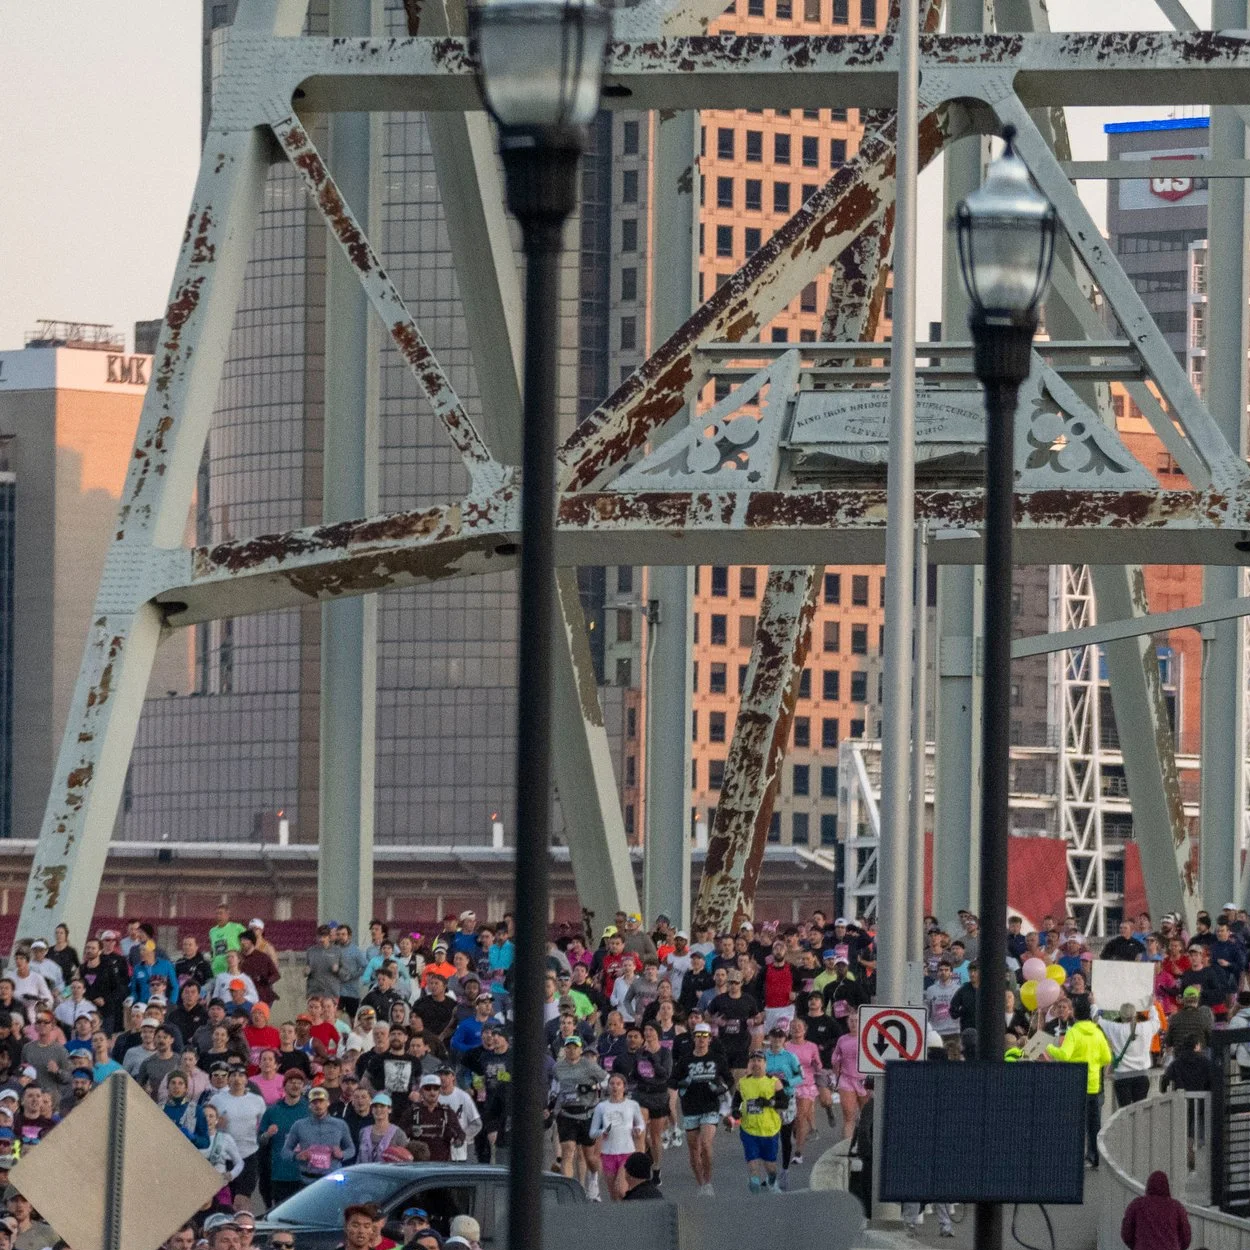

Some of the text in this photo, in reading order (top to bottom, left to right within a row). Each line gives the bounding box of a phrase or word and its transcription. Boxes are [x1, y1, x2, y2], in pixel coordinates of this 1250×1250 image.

[106, 355, 147, 385] KMK
[797, 414, 820, 427] KING
[824, 407, 846, 417] IRON
[850, 401, 888, 411] BRIDGE
[688, 1061, 716, 1075] 26.2
